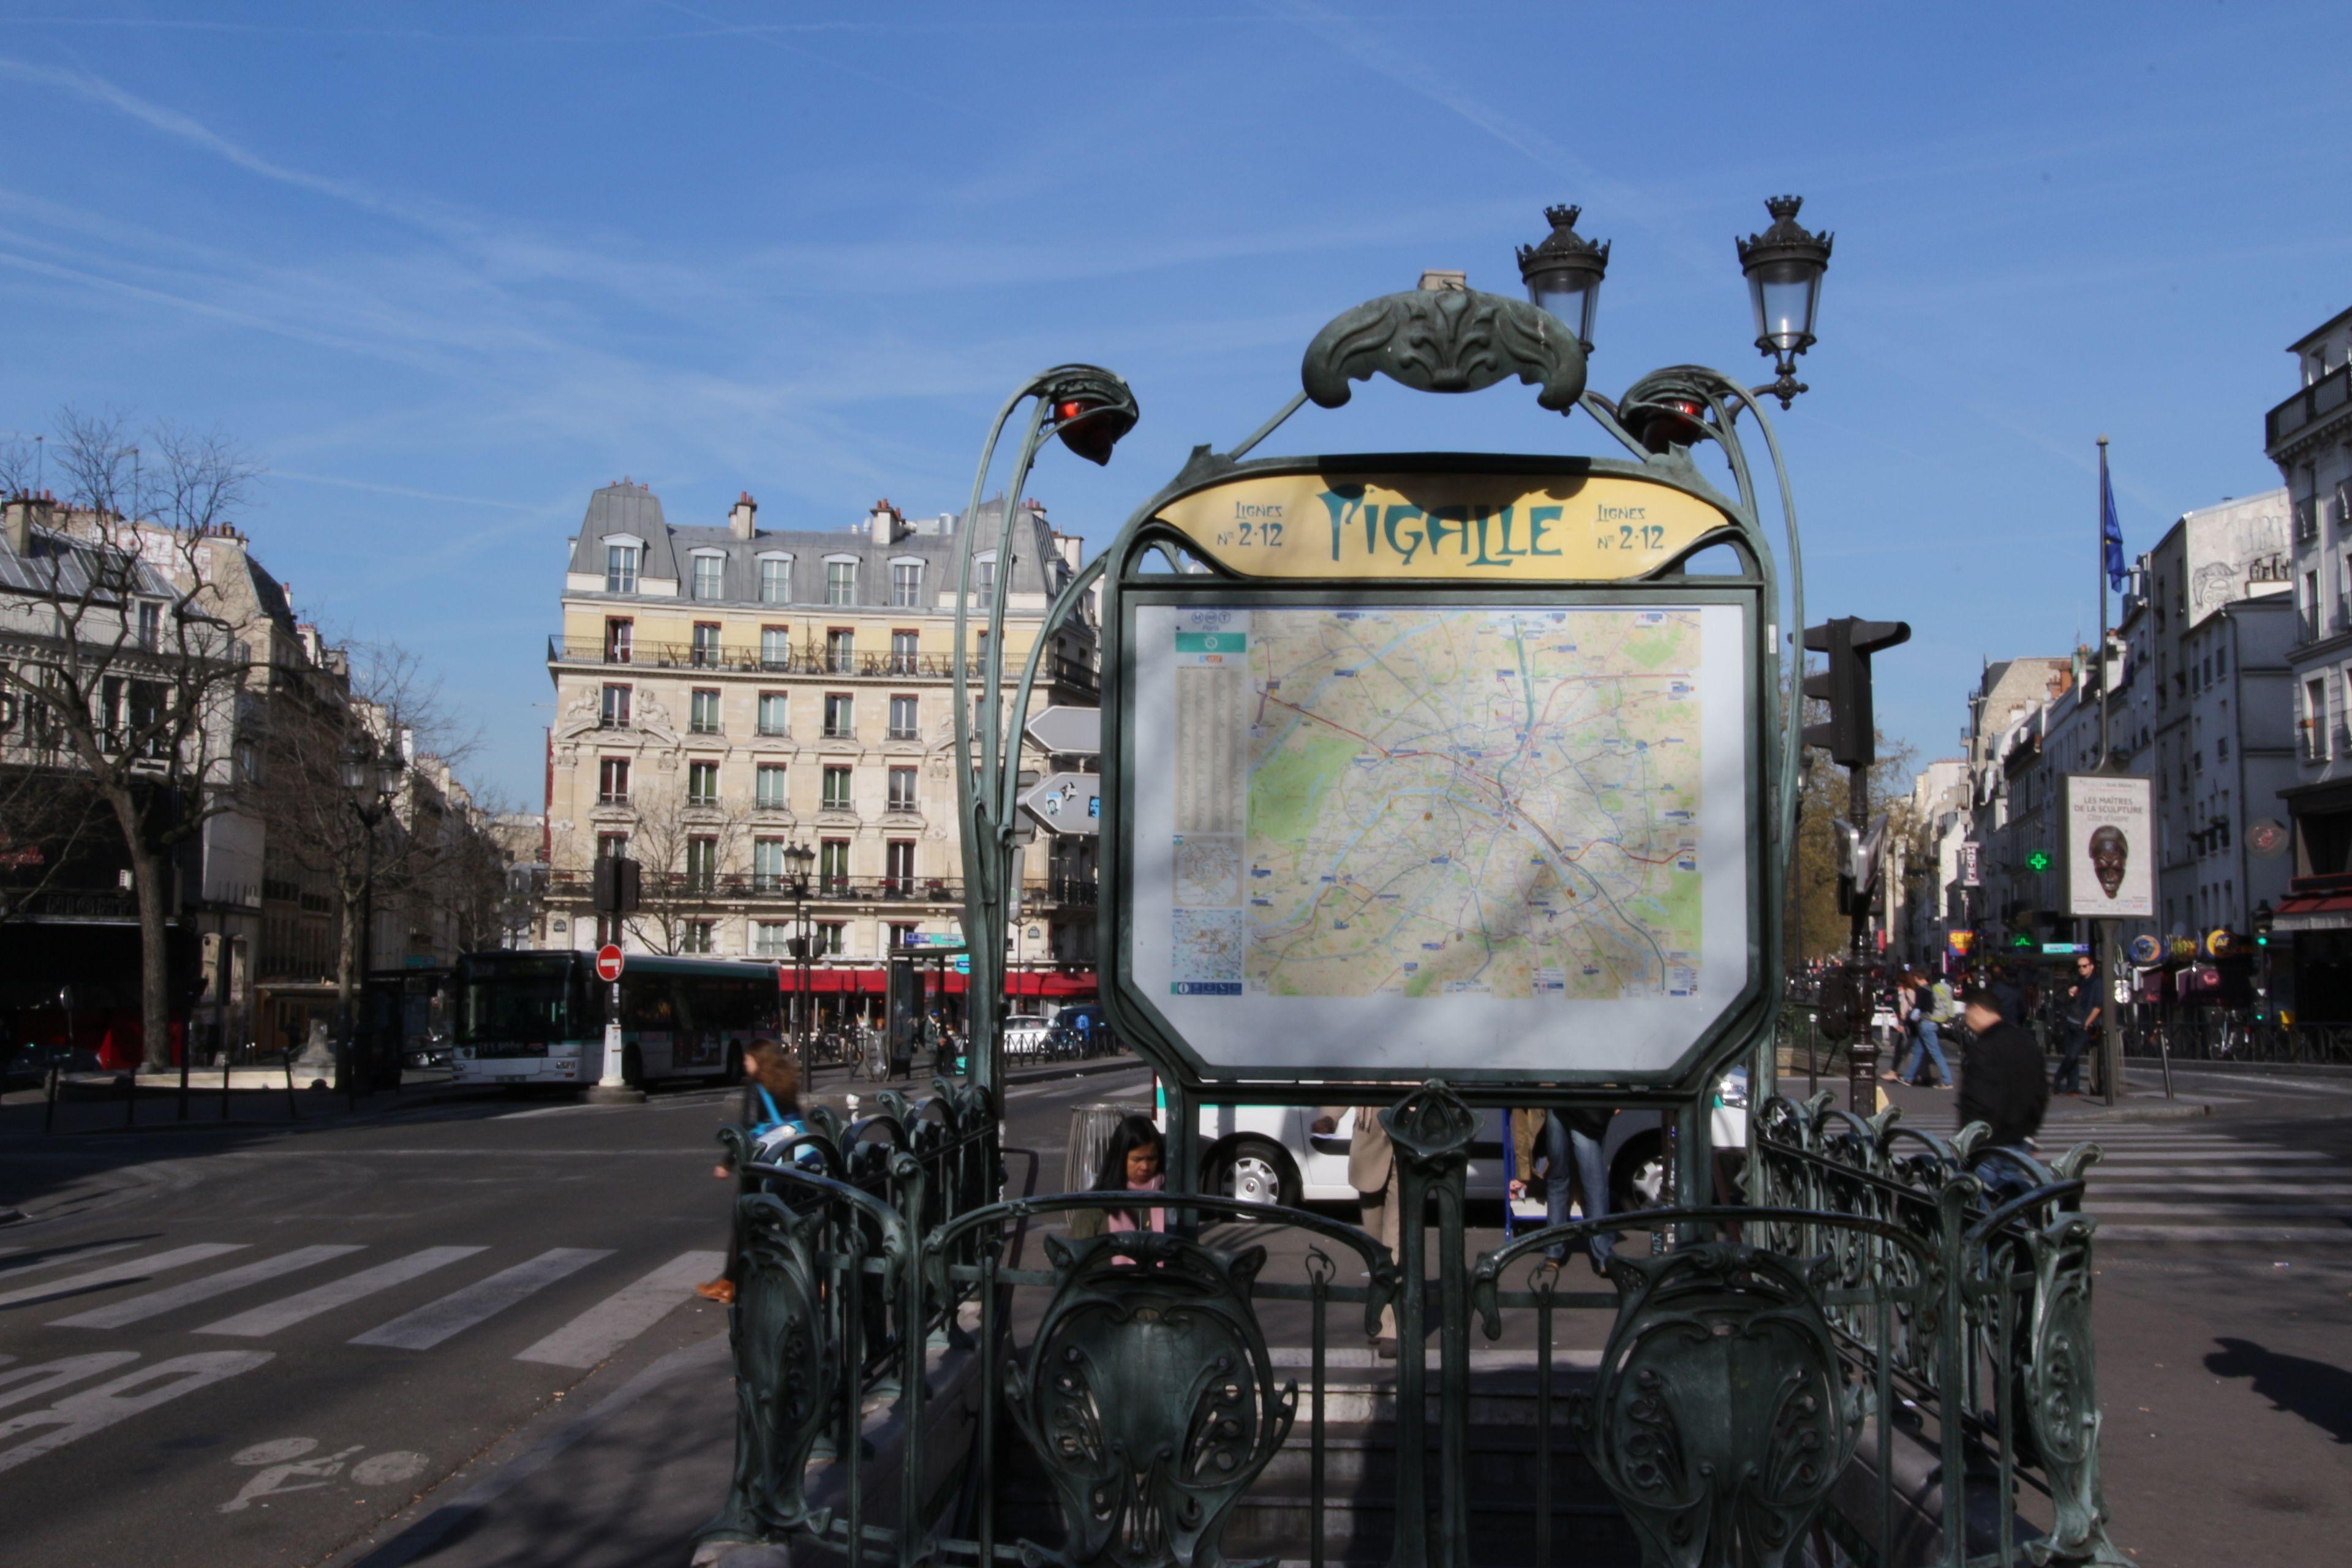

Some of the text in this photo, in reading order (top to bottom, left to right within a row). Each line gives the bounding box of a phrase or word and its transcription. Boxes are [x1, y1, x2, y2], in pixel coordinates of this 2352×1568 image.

[1234, 501, 1283, 519] LIGNES
[1596, 504, 1646, 522] LIGNES
[1316, 483, 1564, 567] PIGALLE
